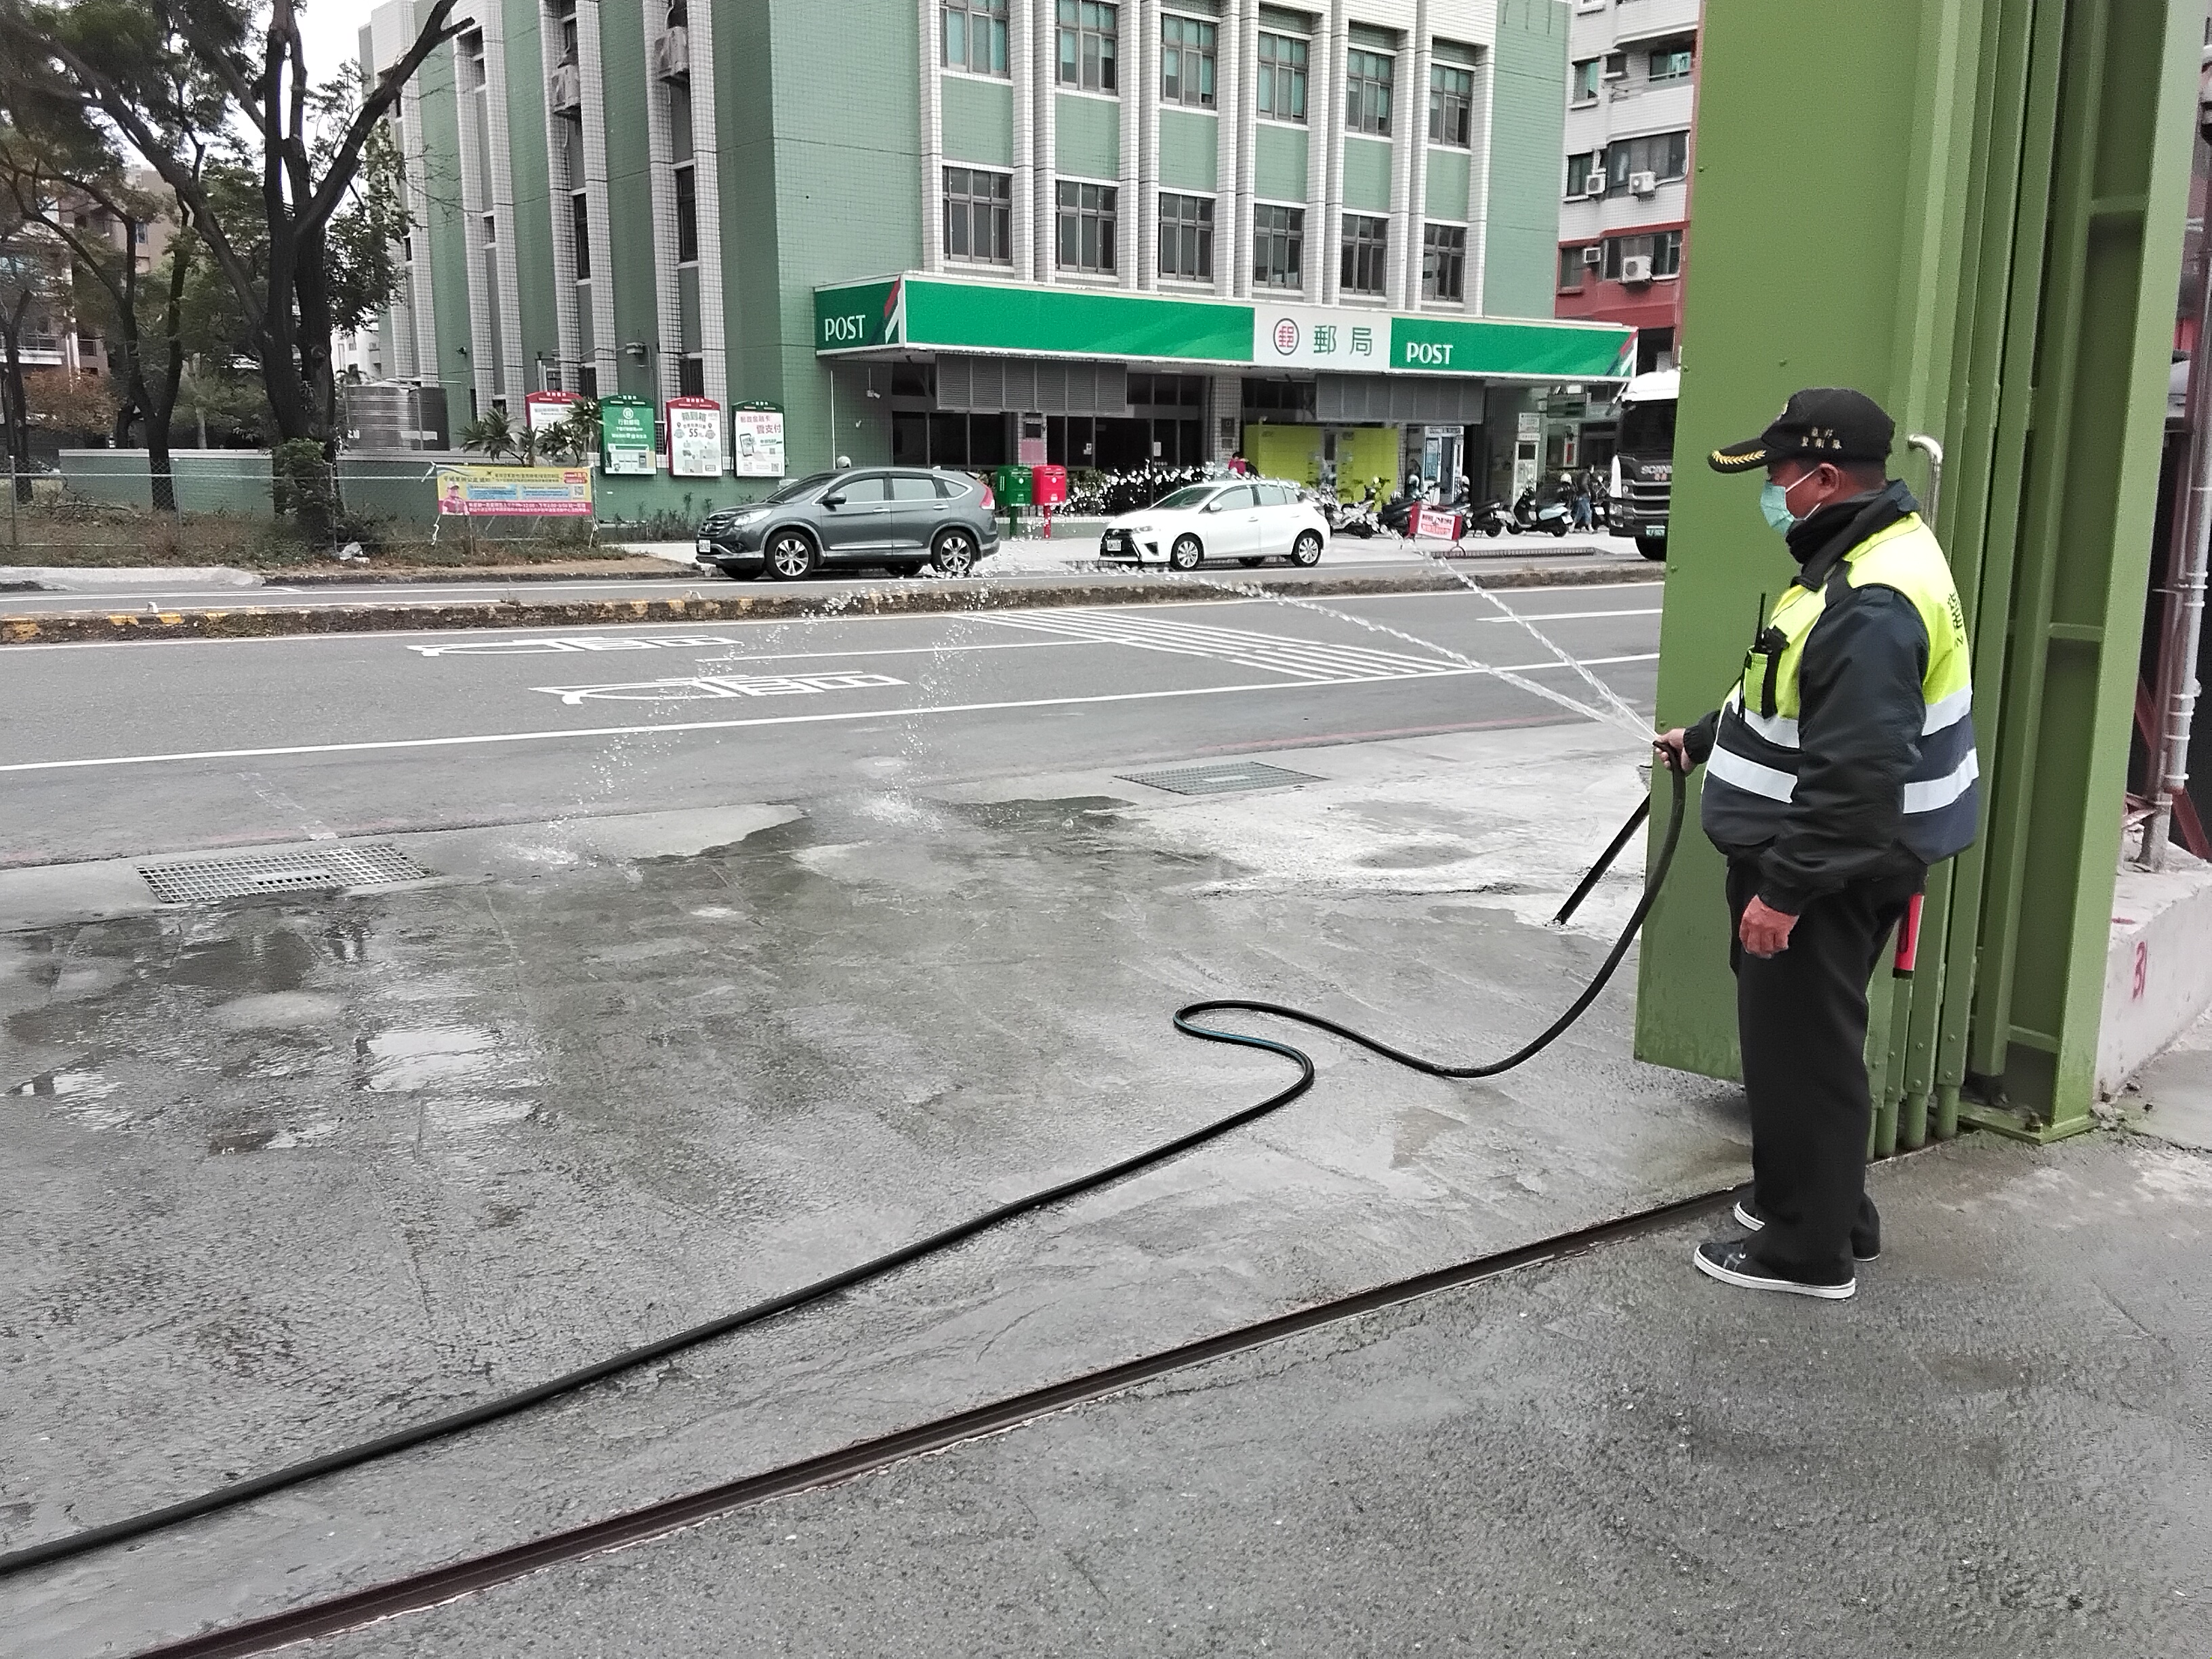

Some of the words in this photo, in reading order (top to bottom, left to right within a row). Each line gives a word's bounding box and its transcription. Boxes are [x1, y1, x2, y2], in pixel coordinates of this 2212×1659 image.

[825, 314, 866, 342] POST
[1313, 324, 1373, 357] 郵局
[1407, 342, 1454, 365] POST
[689, 428, 698, 438] 55
